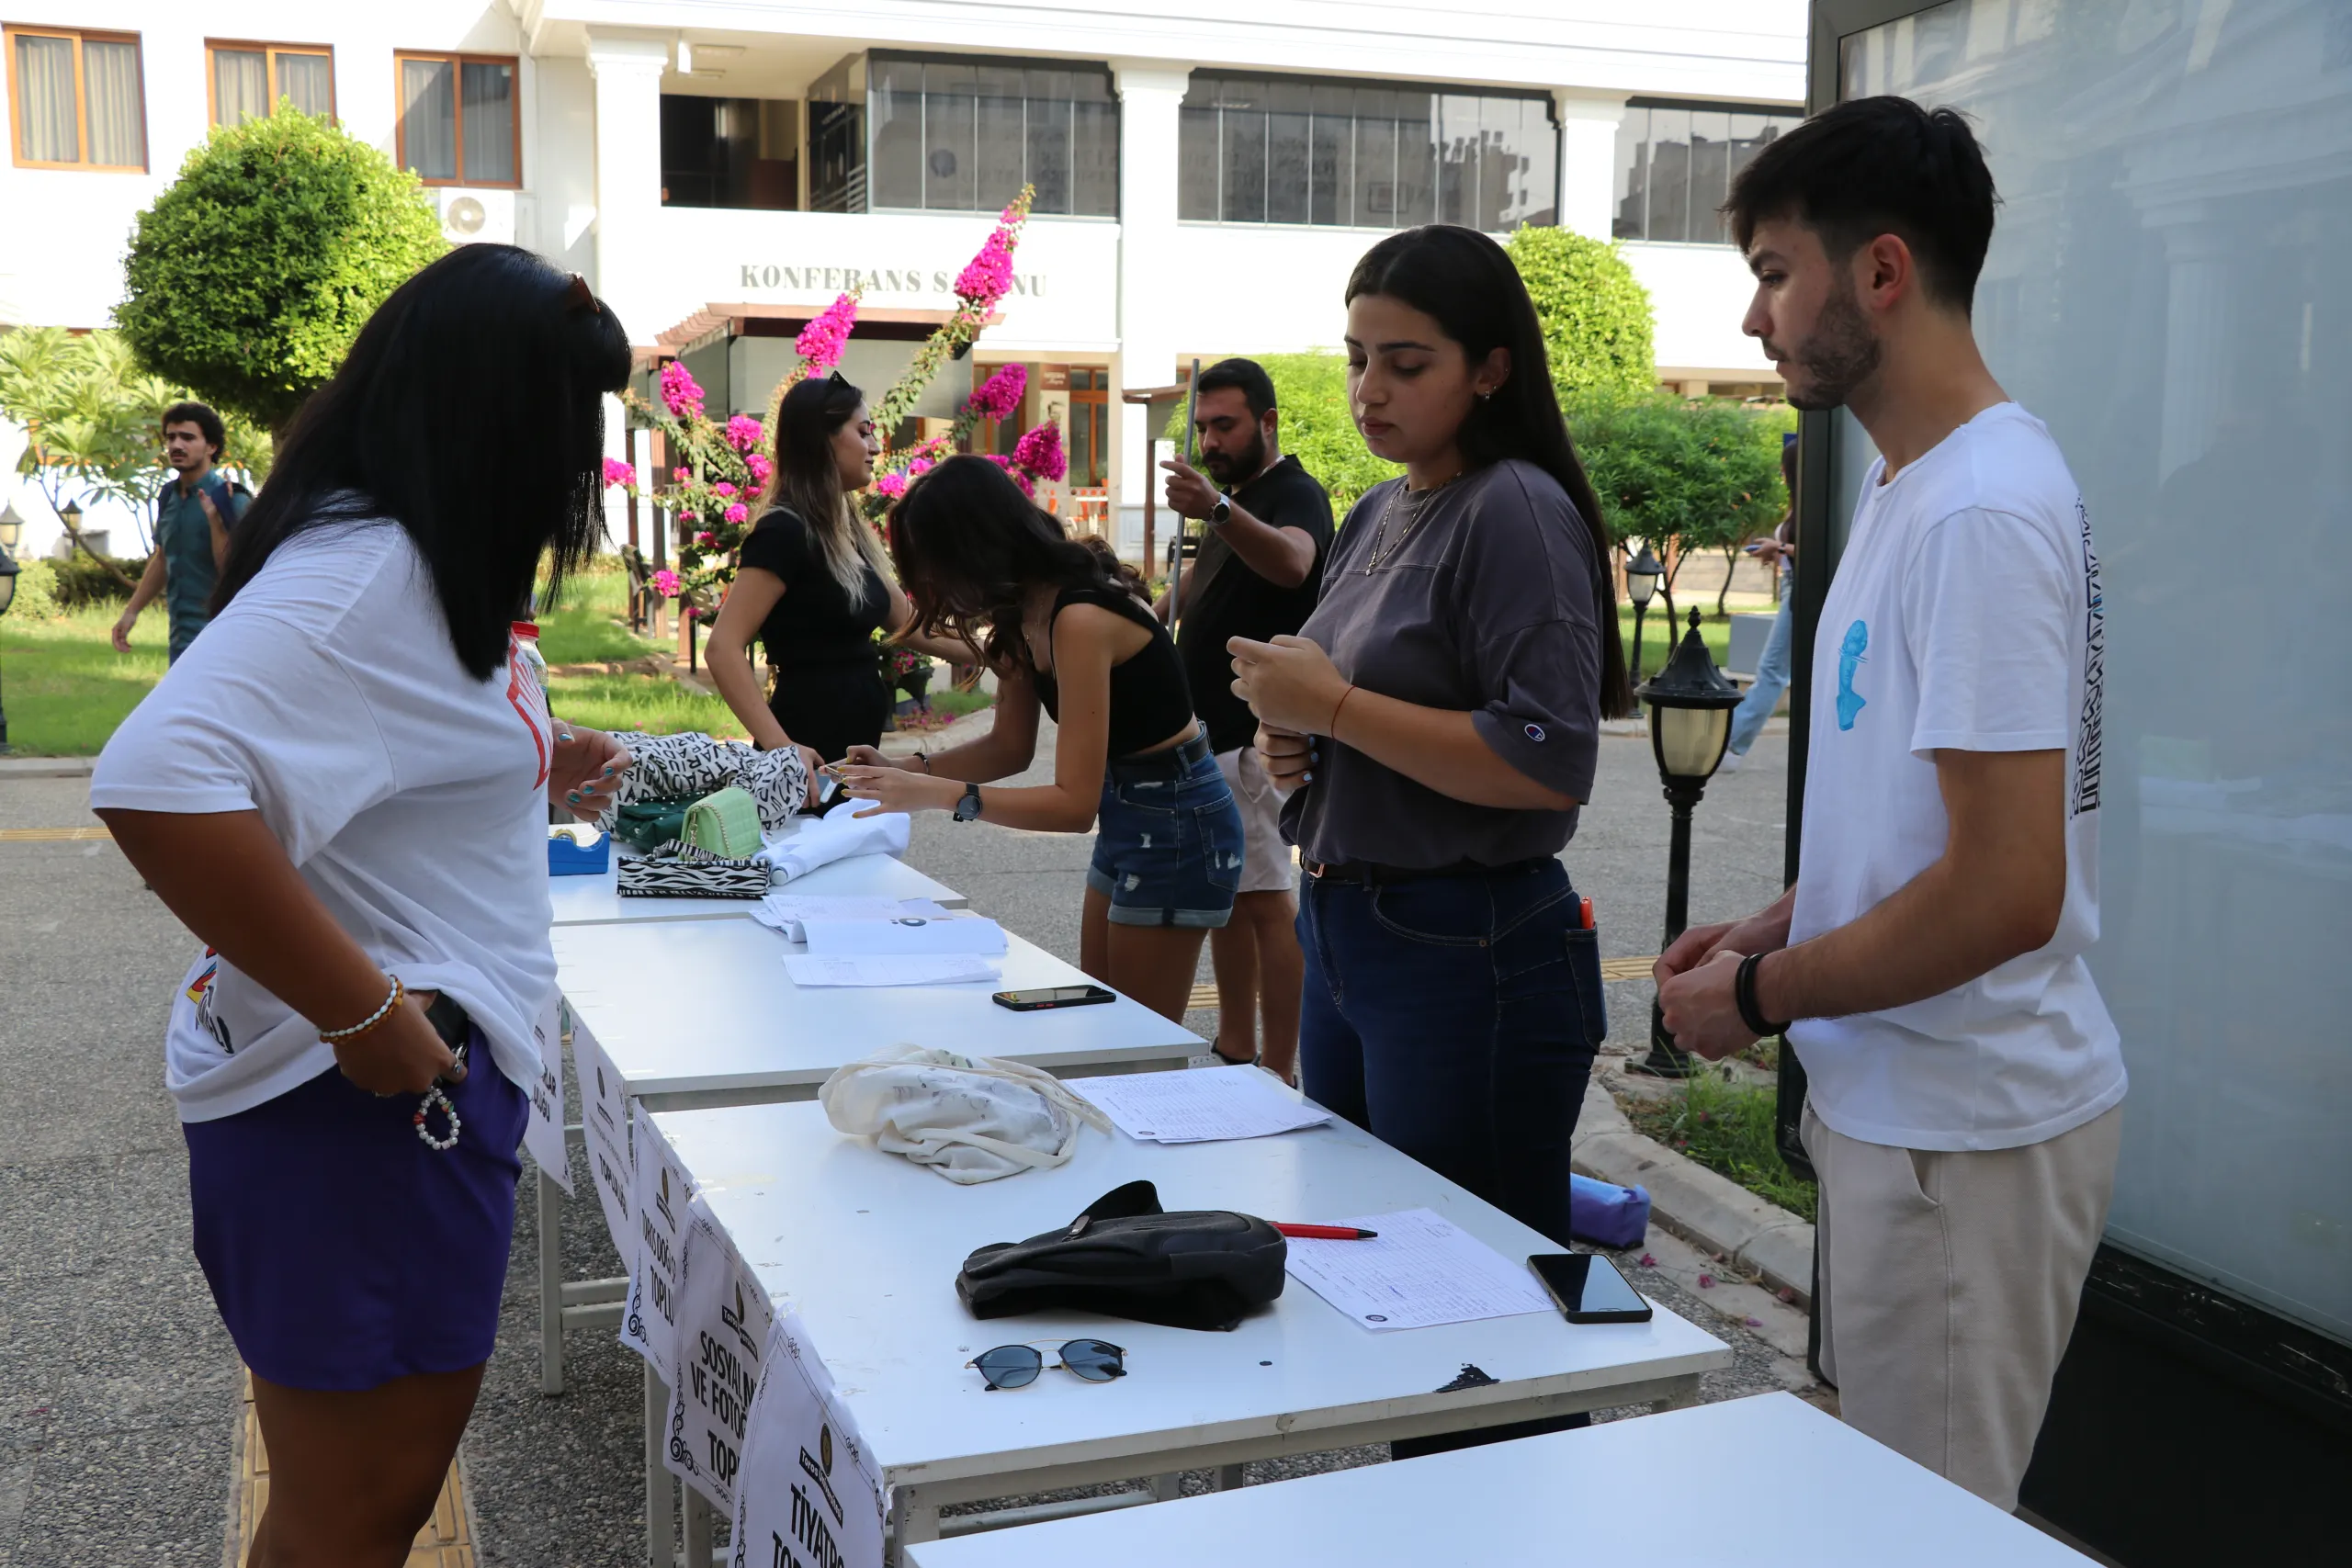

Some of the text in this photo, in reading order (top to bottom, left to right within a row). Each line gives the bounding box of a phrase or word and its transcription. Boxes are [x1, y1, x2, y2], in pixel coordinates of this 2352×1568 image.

[741, 265, 1047, 297] KONFERANS SNU
[691, 1360, 707, 1407] VE
[707, 1429, 741, 1488] TOP
[801, 1450, 819, 1477] Toros
